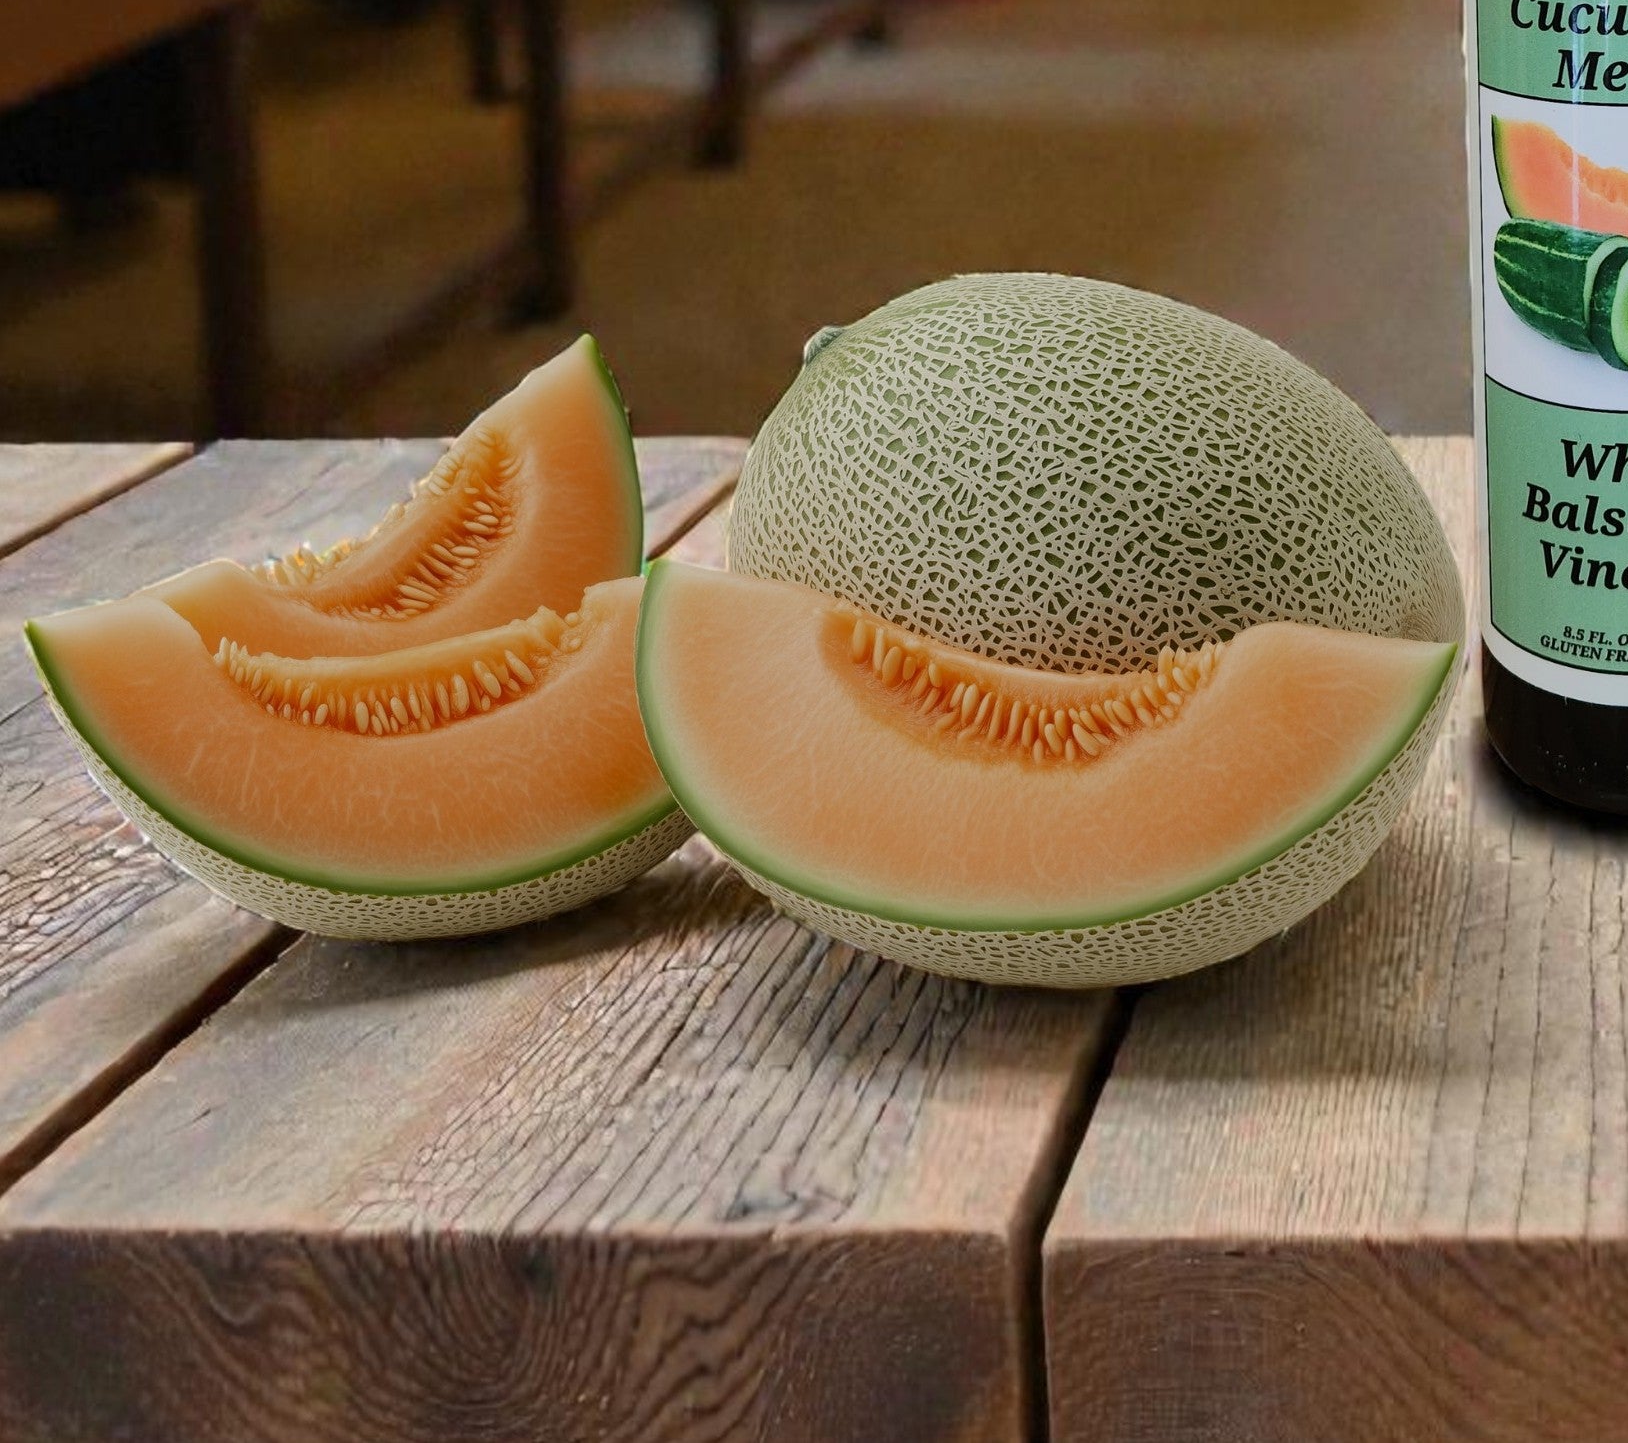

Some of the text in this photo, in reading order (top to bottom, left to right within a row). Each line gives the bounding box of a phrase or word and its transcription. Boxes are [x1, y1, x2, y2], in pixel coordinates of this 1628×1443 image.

[1540, 634, 1603, 661] GLUTEN
[1563, 625, 1585, 641] 8.5
[1588, 630, 1613, 646] FL.
